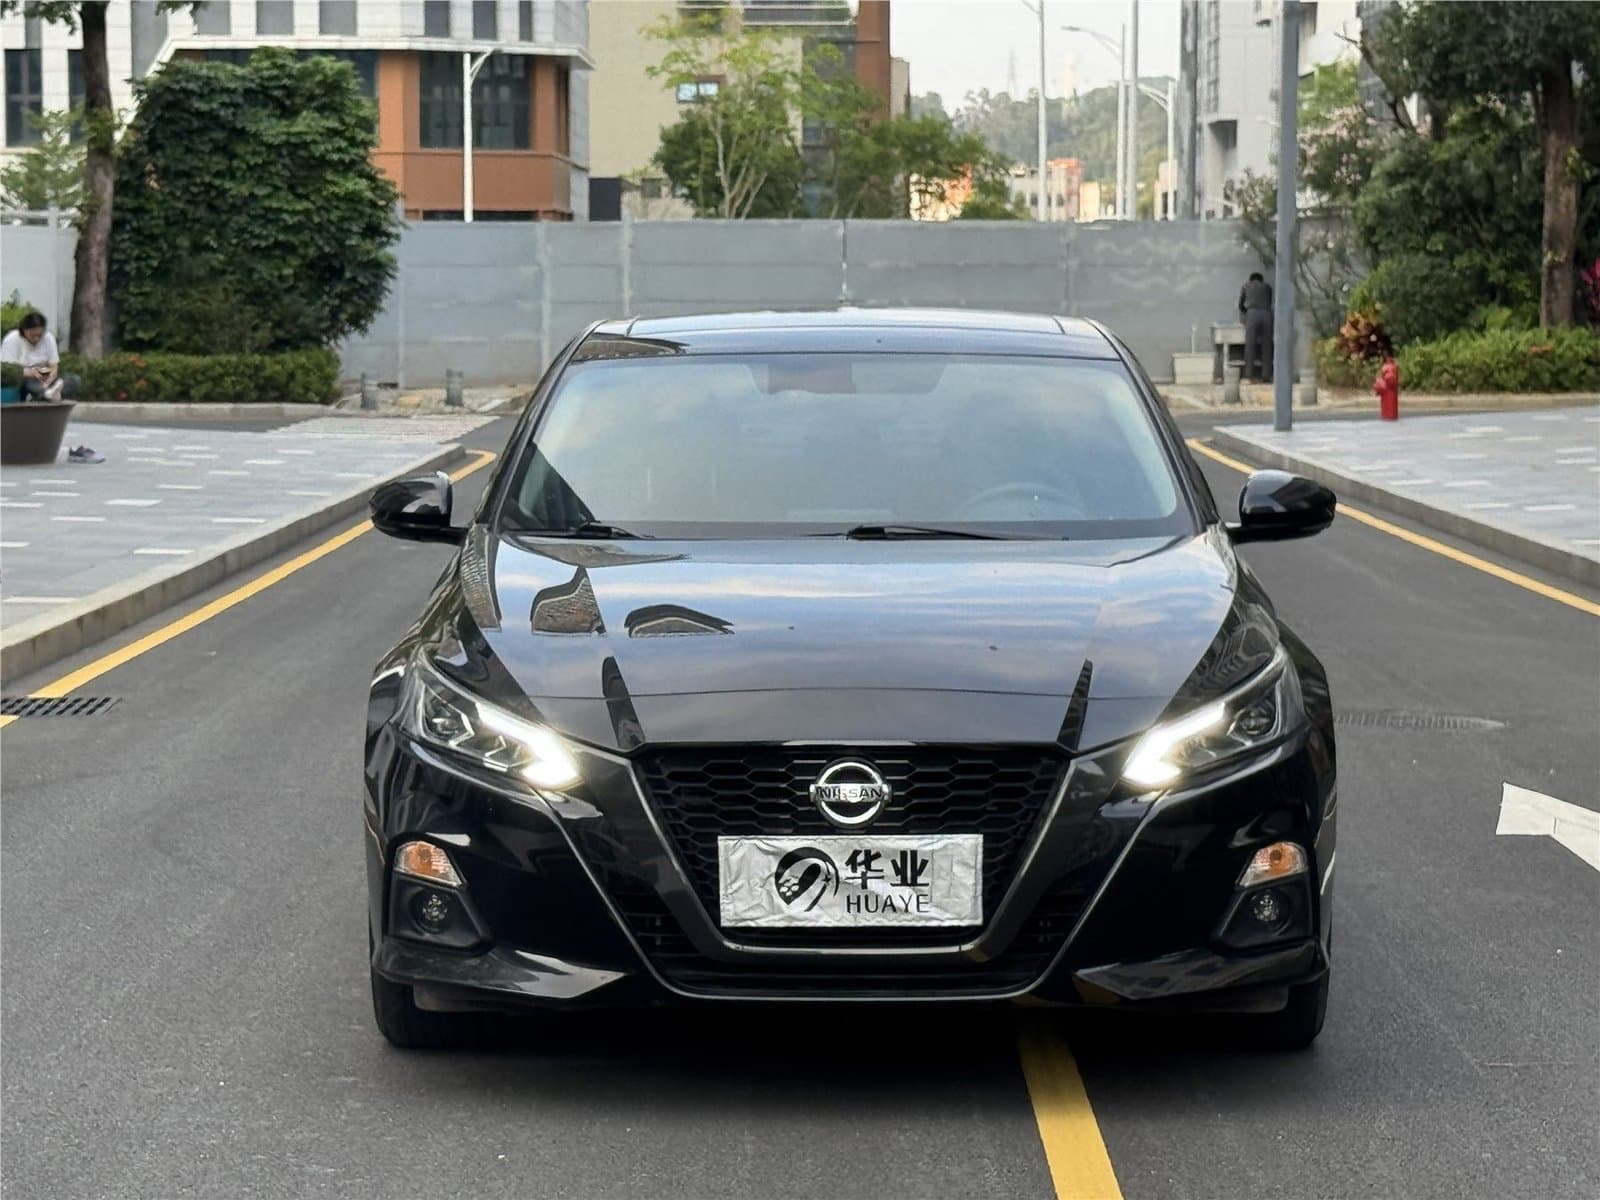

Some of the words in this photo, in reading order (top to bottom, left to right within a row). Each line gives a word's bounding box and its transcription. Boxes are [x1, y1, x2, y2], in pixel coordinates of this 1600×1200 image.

[817, 785, 883, 800] NISSAN
[845, 849, 929, 889] 华业
[846, 894, 929, 913] HUAYE
